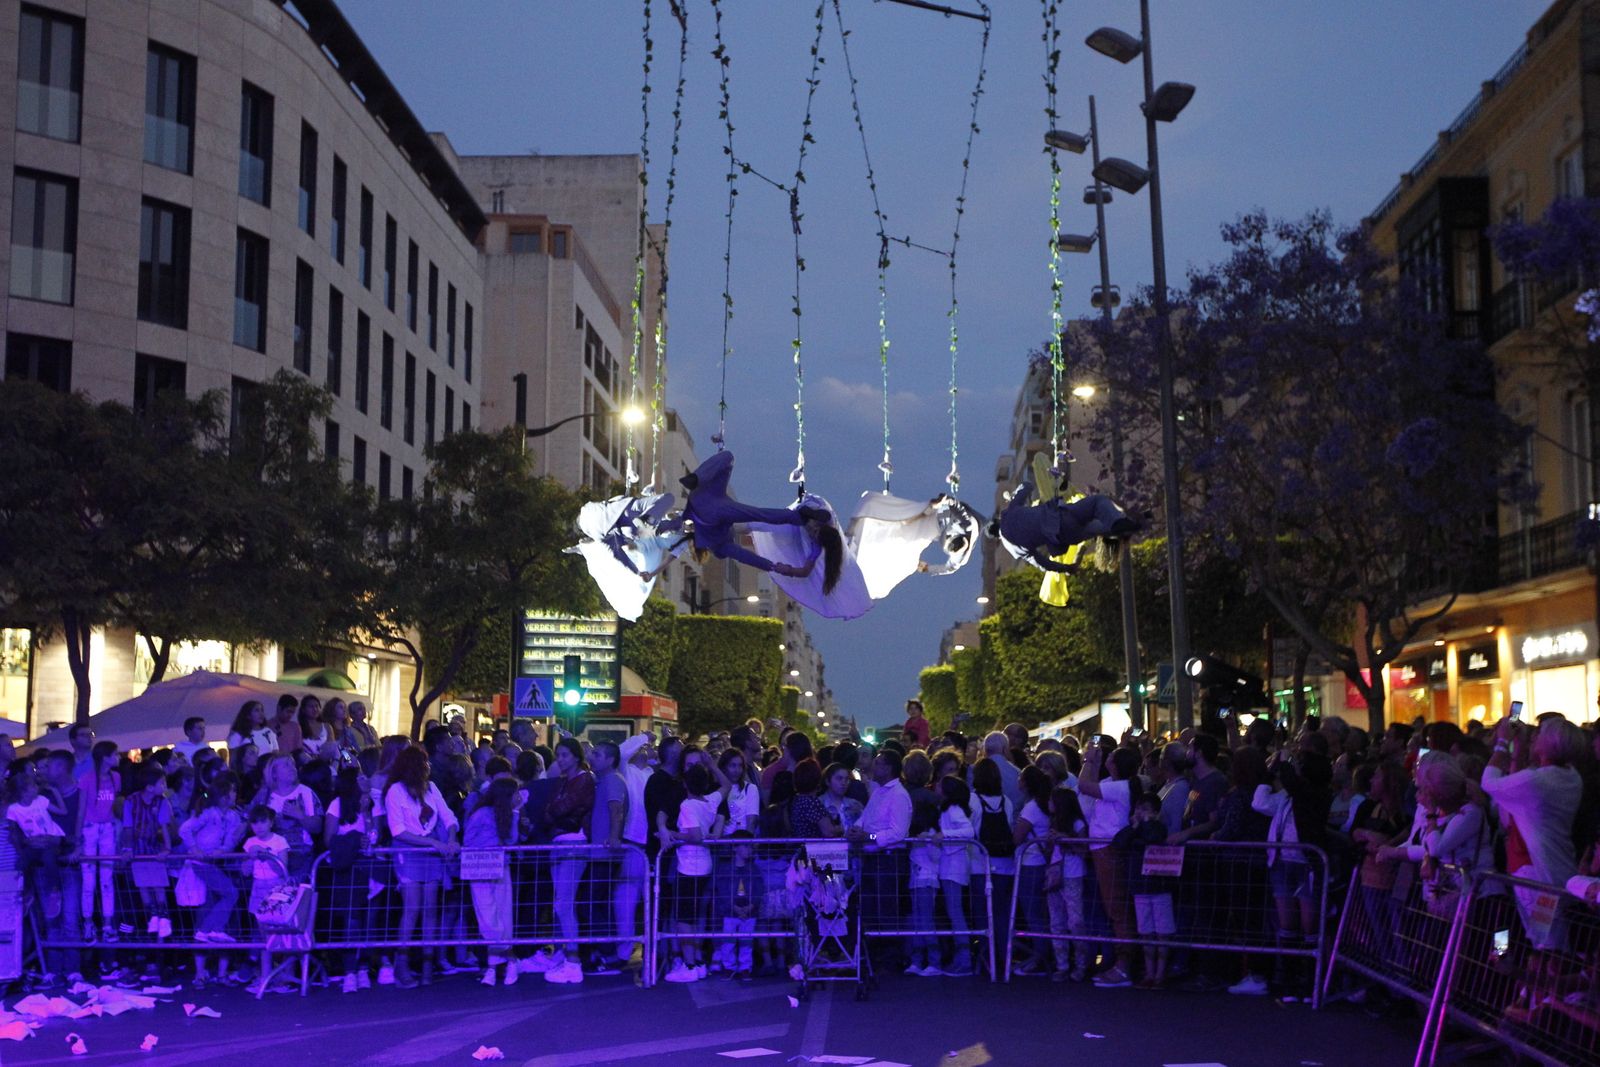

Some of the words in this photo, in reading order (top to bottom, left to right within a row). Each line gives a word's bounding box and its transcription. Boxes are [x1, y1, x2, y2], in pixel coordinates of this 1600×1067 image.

[524, 623, 555, 632] VERDES
[559, 624, 571, 632] ES
[533, 637, 545, 645] LA
[548, 637, 601, 646] NATURALEZA
[524, 650, 545, 659] BUEN
[590, 651, 601, 659] DE
[605, 651, 616, 659] LA
